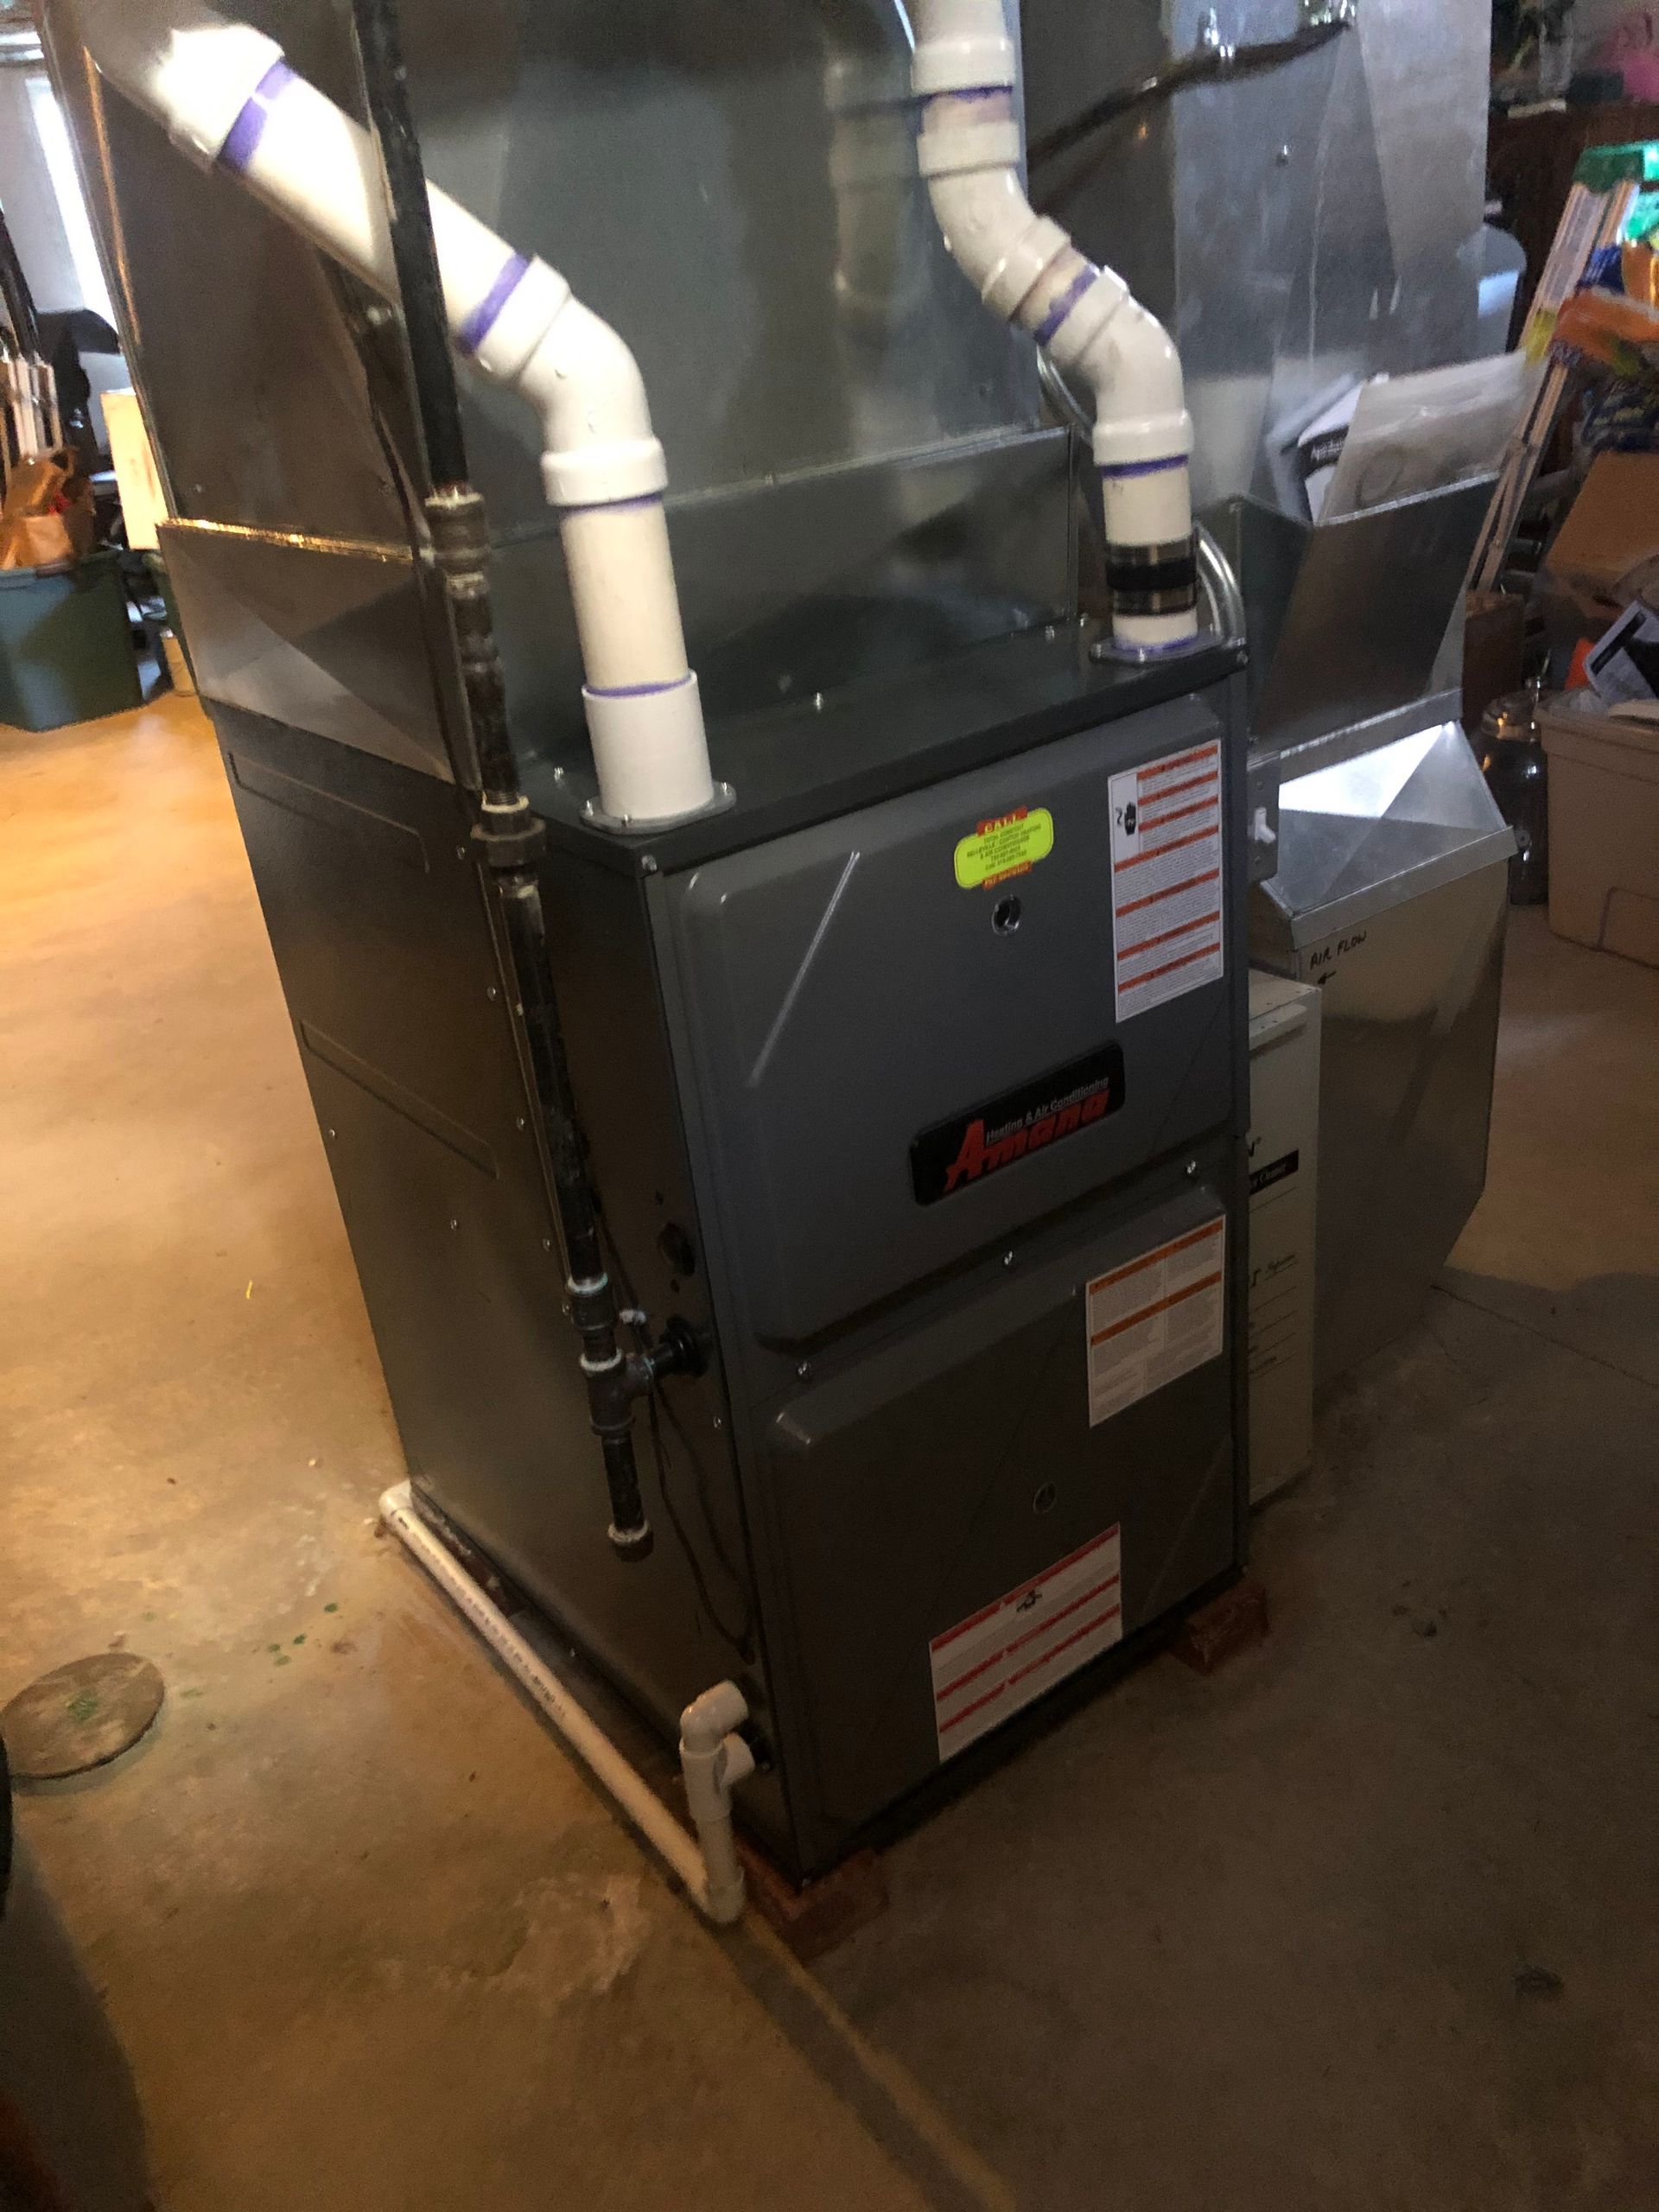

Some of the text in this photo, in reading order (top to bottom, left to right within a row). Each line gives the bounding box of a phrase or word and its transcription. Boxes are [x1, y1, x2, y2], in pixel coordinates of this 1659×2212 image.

[1310, 931, 1367, 970] AIR FLOW
[986, 1077, 1109, 1147] Heating & Air Conditioning
[944, 1119, 1110, 1193] Amana
